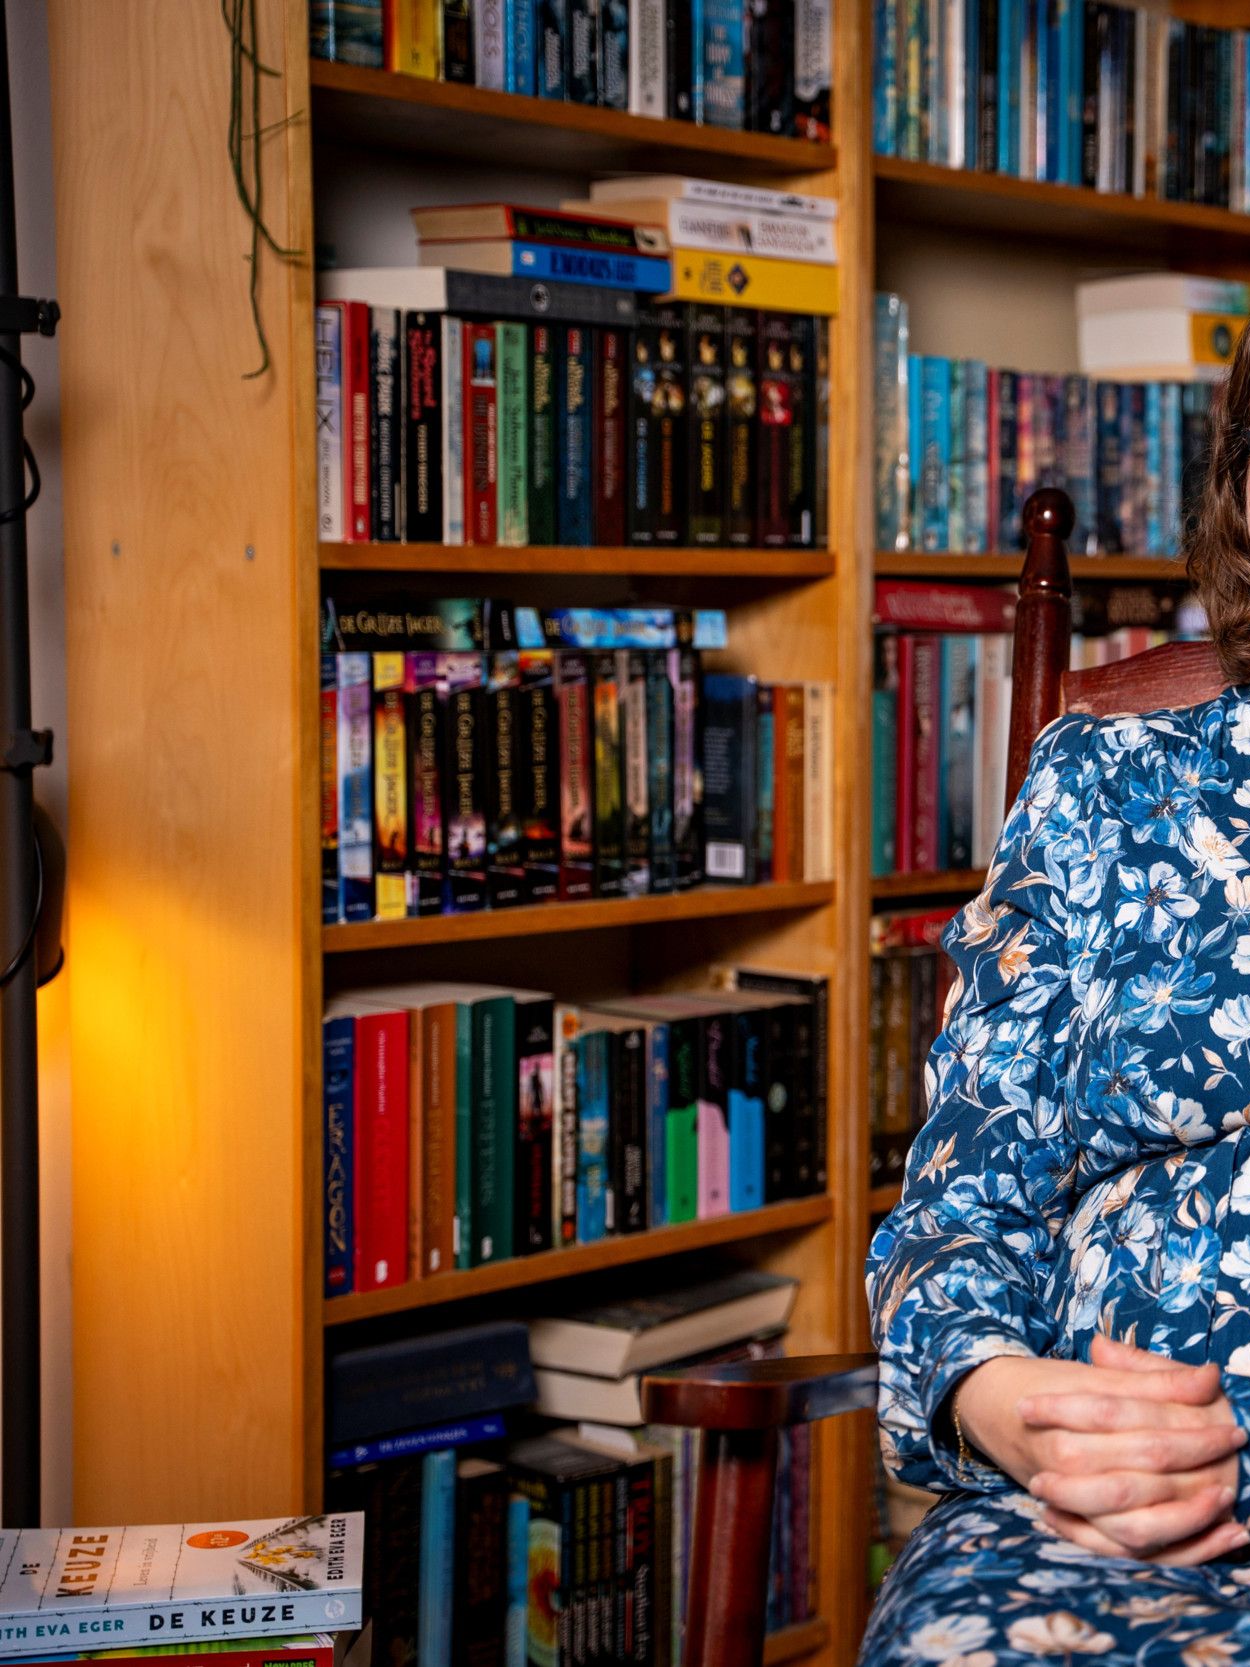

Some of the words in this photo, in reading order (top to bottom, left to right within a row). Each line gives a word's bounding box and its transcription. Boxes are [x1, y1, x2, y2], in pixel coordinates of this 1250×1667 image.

[316, 318, 336, 433] HELIX
[327, 1102, 347, 1256] ERAGON
[330, 1518, 347, 1538] EGER
[329, 1539, 345, 1555] EVA
[19, 1562, 41, 1575] DE
[56, 1534, 109, 1598] KEUZE
[327, 1556, 344, 1581] EDITH
[35, 1623, 70, 1638] EVA
[79, 1618, 125, 1634] EGER
[149, 1612, 184, 1632] DE
[201, 1604, 295, 1627] KEUZE
